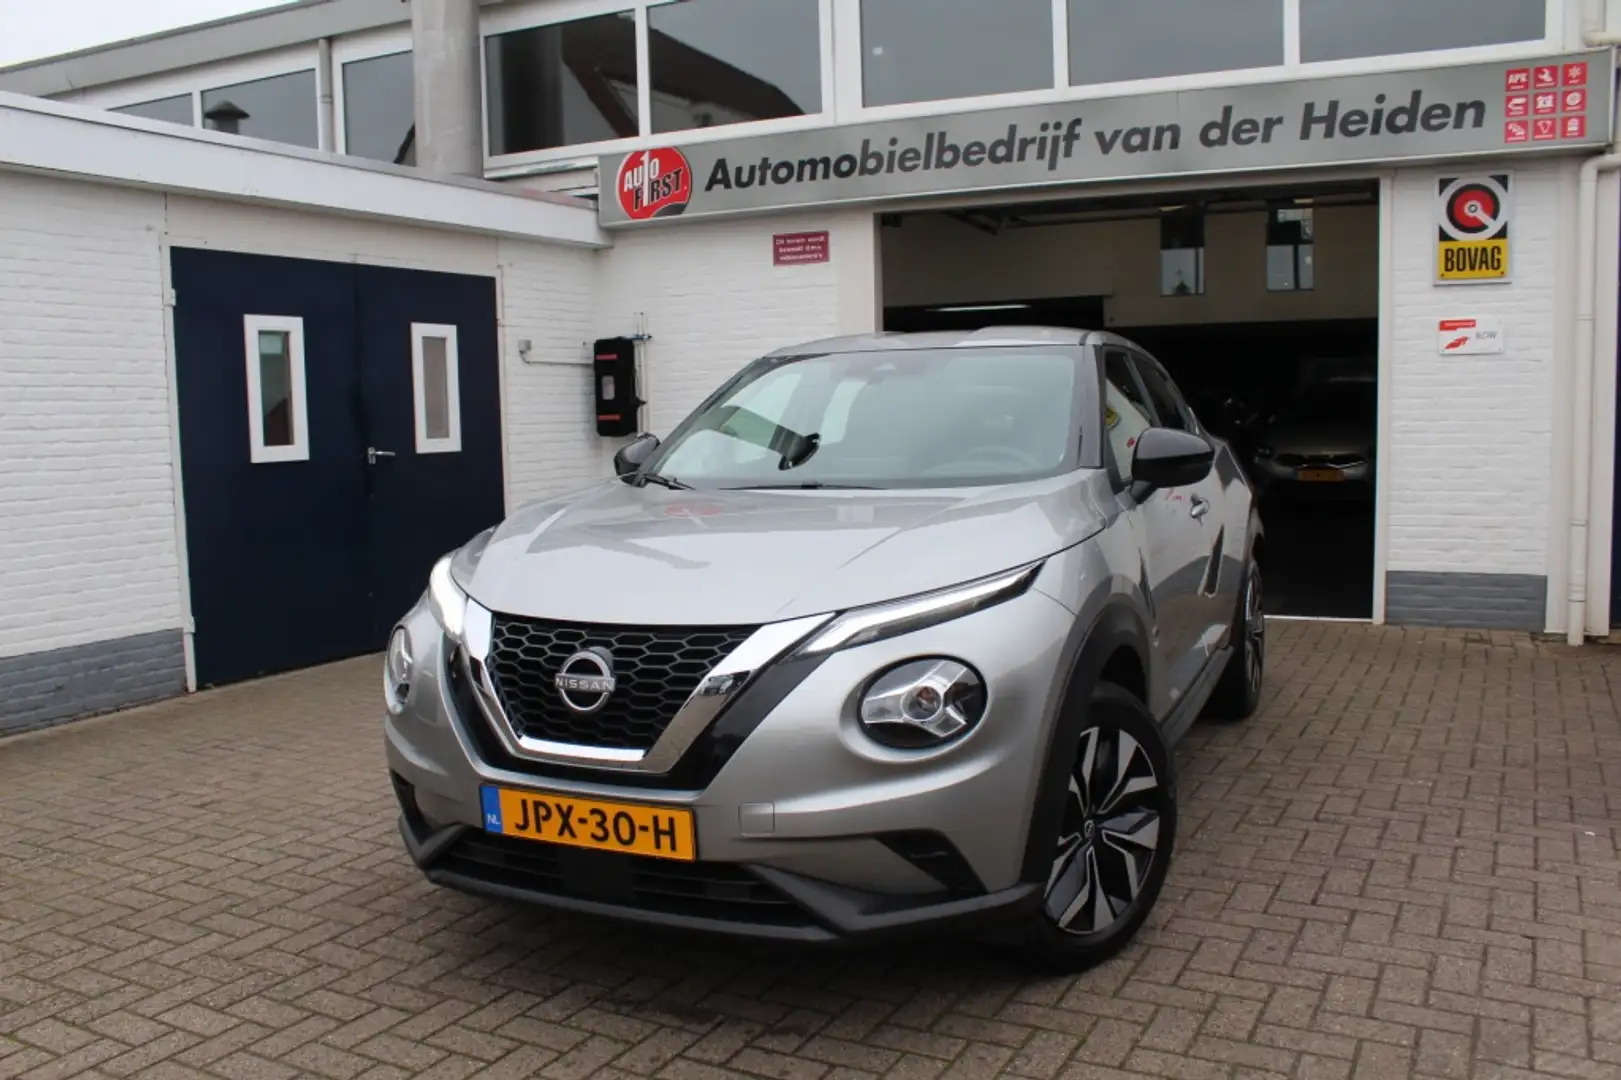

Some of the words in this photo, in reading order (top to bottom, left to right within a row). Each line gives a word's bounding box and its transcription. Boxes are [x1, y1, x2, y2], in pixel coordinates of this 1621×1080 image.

[1508, 73, 1528, 84] APK
[704, 117, 1083, 192] Automobielbedrijf
[1094, 123, 1181, 155] van
[1199, 105, 1284, 148] der
[1300, 89, 1486, 140] Heiden
[1444, 245, 1501, 272] BOVAG
[555, 676, 615, 691] NISSAN
[487, 813, 501, 825] NL
[515, 798, 677, 852] JPX-30-H
